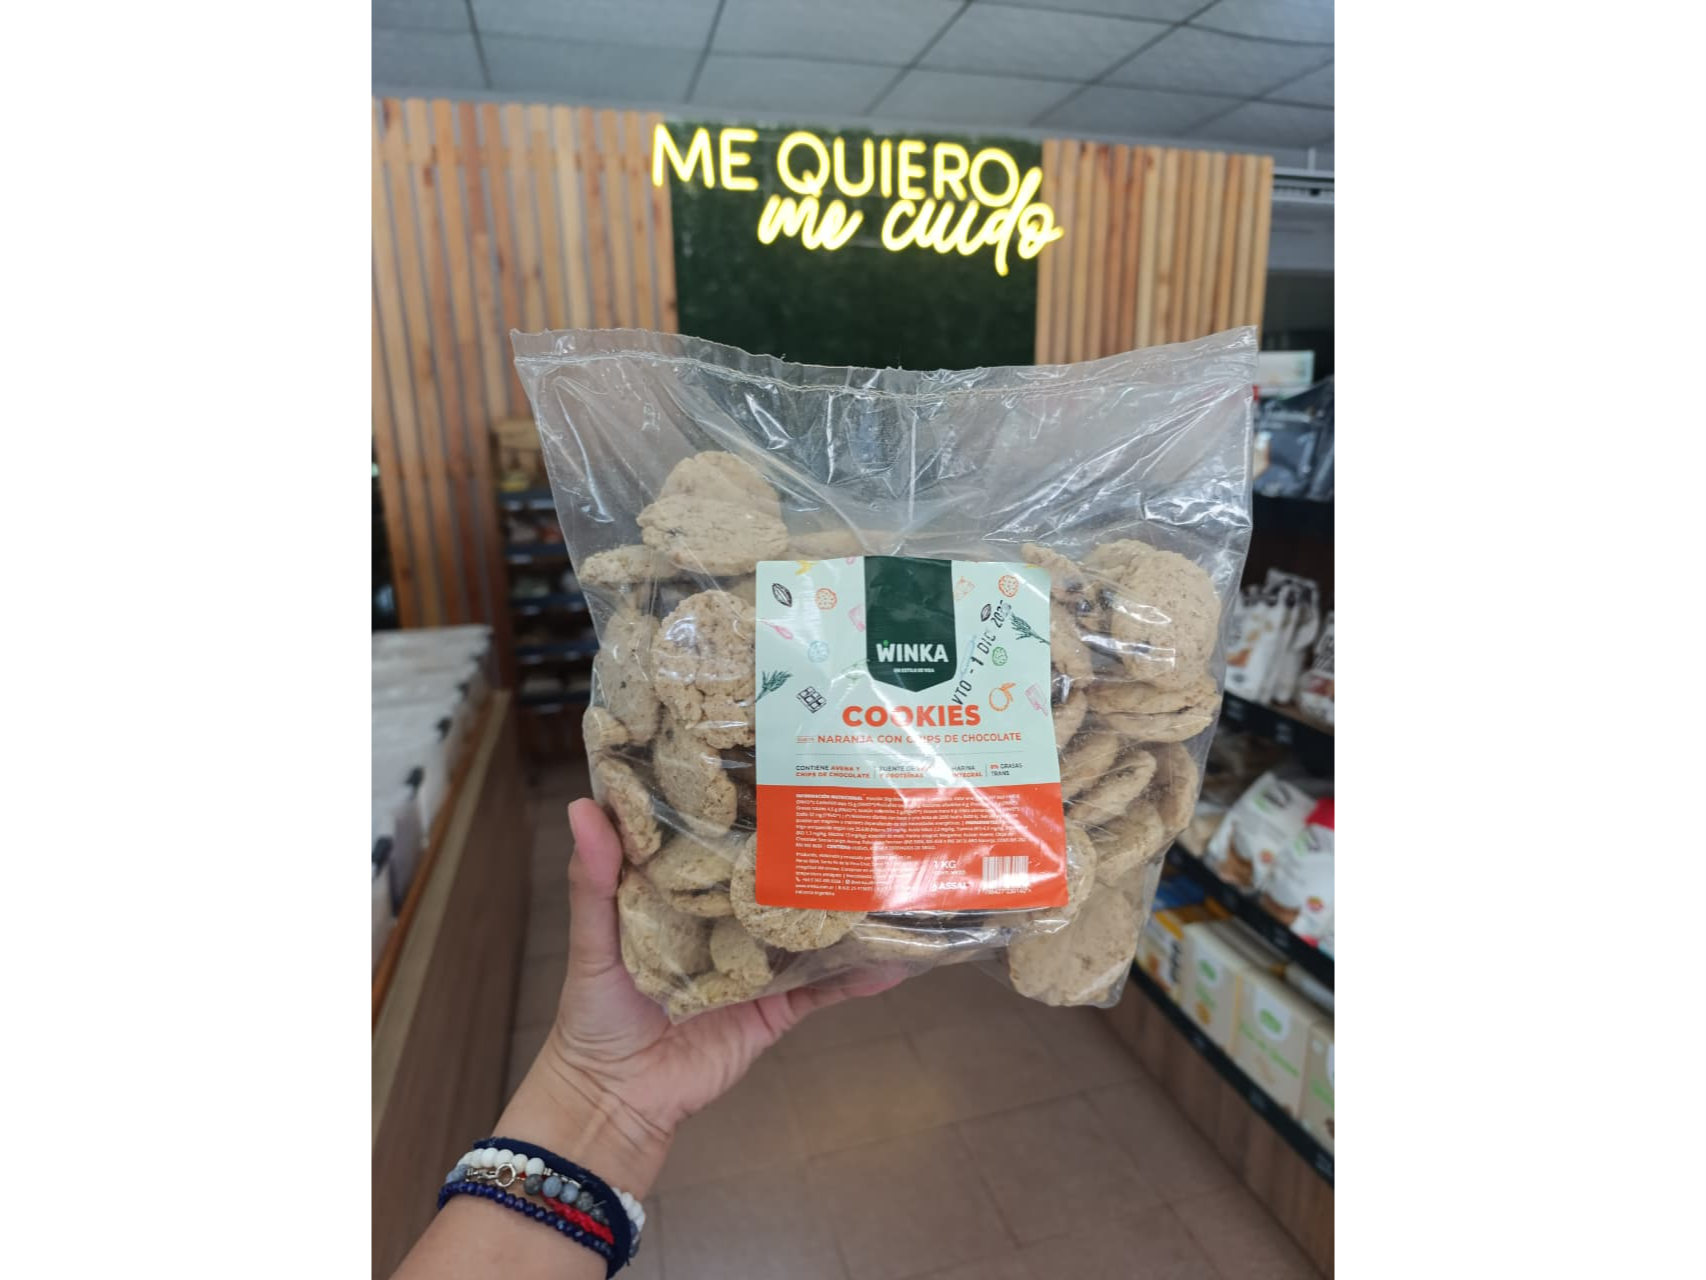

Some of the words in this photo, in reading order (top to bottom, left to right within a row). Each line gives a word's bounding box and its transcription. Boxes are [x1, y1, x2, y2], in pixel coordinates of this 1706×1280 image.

[652, 123, 759, 191] ME
[777, 131, 1020, 207] QUIERO
[757, 194, 864, 251] me
[881, 166, 1063, 276] cuido
[876, 642, 949, 662] WINKA
[951, 680, 972, 705] VTO
[977, 631, 996, 655] DIC
[817, 735, 873, 744] NARANJA
[877, 735, 902, 743] CON
[906, 734, 941, 743] CIPS
[944, 734, 958, 743] DE
[961, 732, 1022, 742] CHOCOLATE
[842, 705, 981, 727] COOKIES
